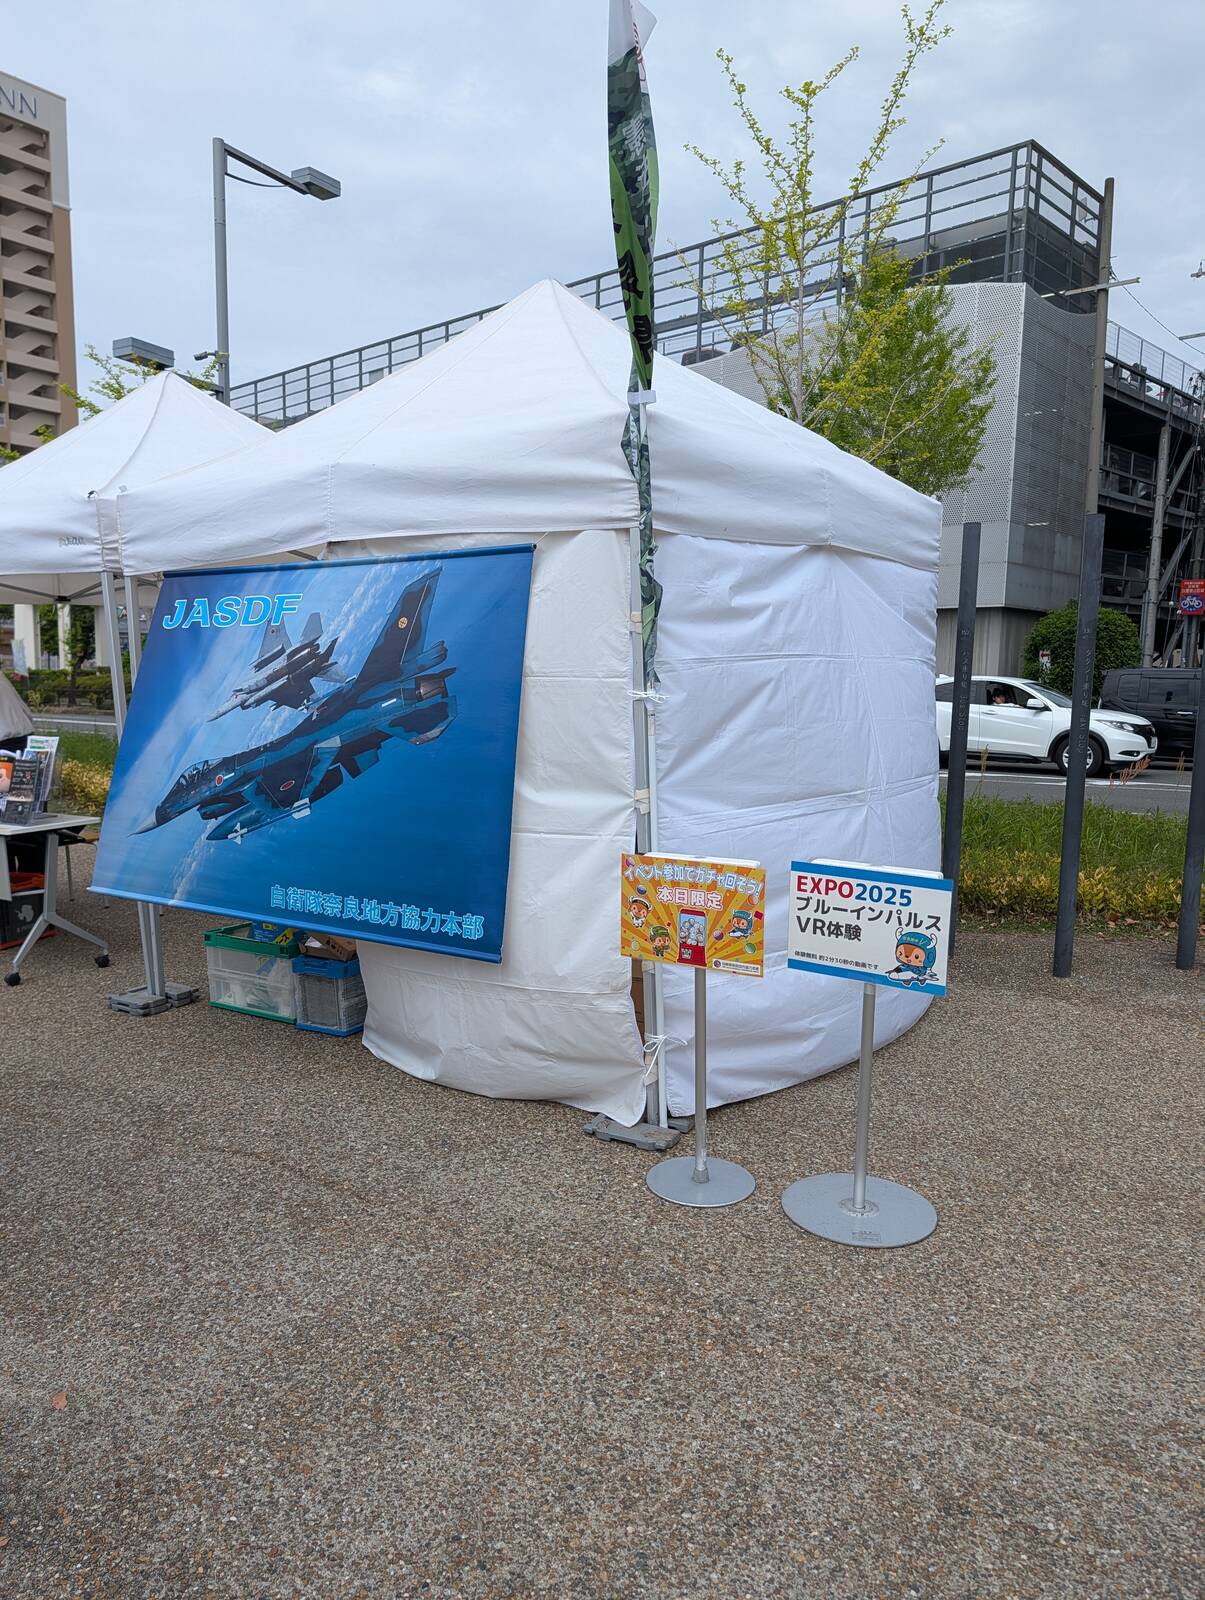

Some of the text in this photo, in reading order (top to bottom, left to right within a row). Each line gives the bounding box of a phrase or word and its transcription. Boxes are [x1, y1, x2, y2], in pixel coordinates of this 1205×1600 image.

[162, 593, 303, 630] JASDF
[656, 886, 723, 910] 本日限定
[796, 875, 912, 907] EXPO2025
[271, 884, 485, 940] 自衛隊奈良地方協力本部
[796, 896, 942, 932] ブルーインパルス
[796, 915, 862, 942] VR体験
